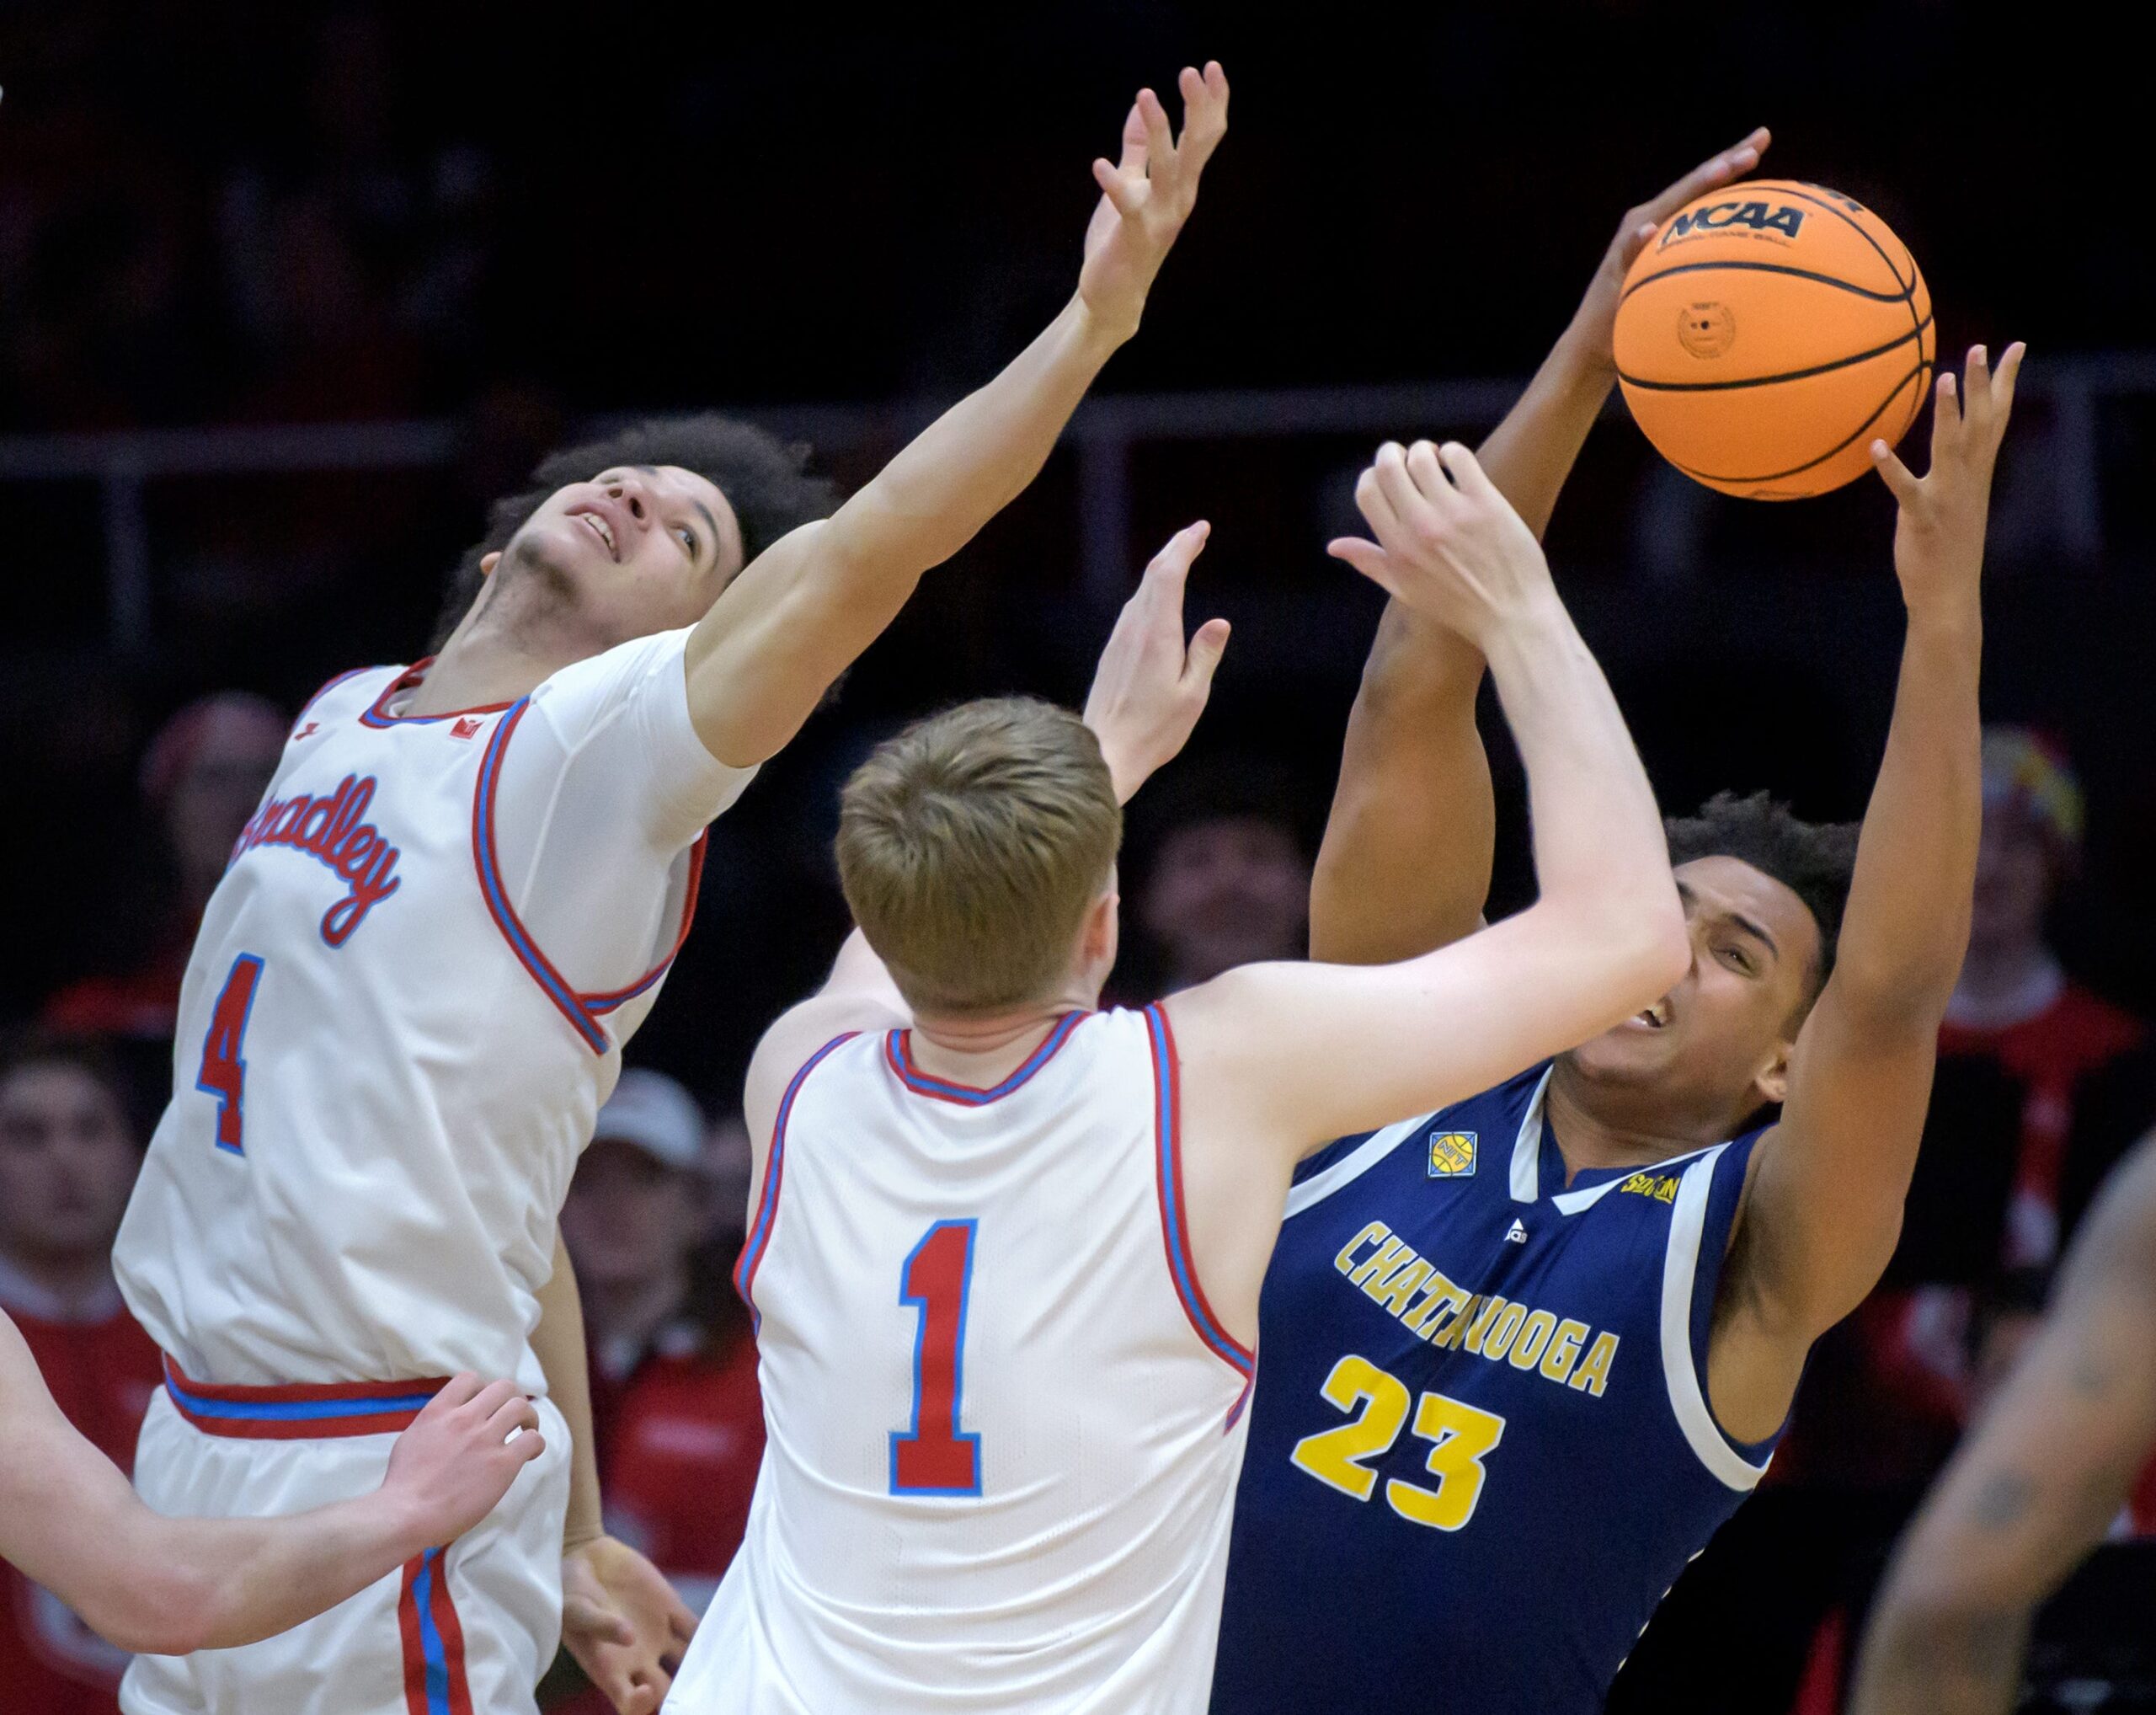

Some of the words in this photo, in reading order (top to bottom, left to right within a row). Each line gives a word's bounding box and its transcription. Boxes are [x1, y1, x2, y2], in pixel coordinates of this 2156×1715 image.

[1658, 201, 1805, 245] NCAA
[226, 772, 402, 949] radley
[195, 952, 265, 1157] 4
[1437, 1139, 1470, 1166] NIT
[889, 1218, 983, 1497] 1
[1289, 1354, 1506, 1531] 23
